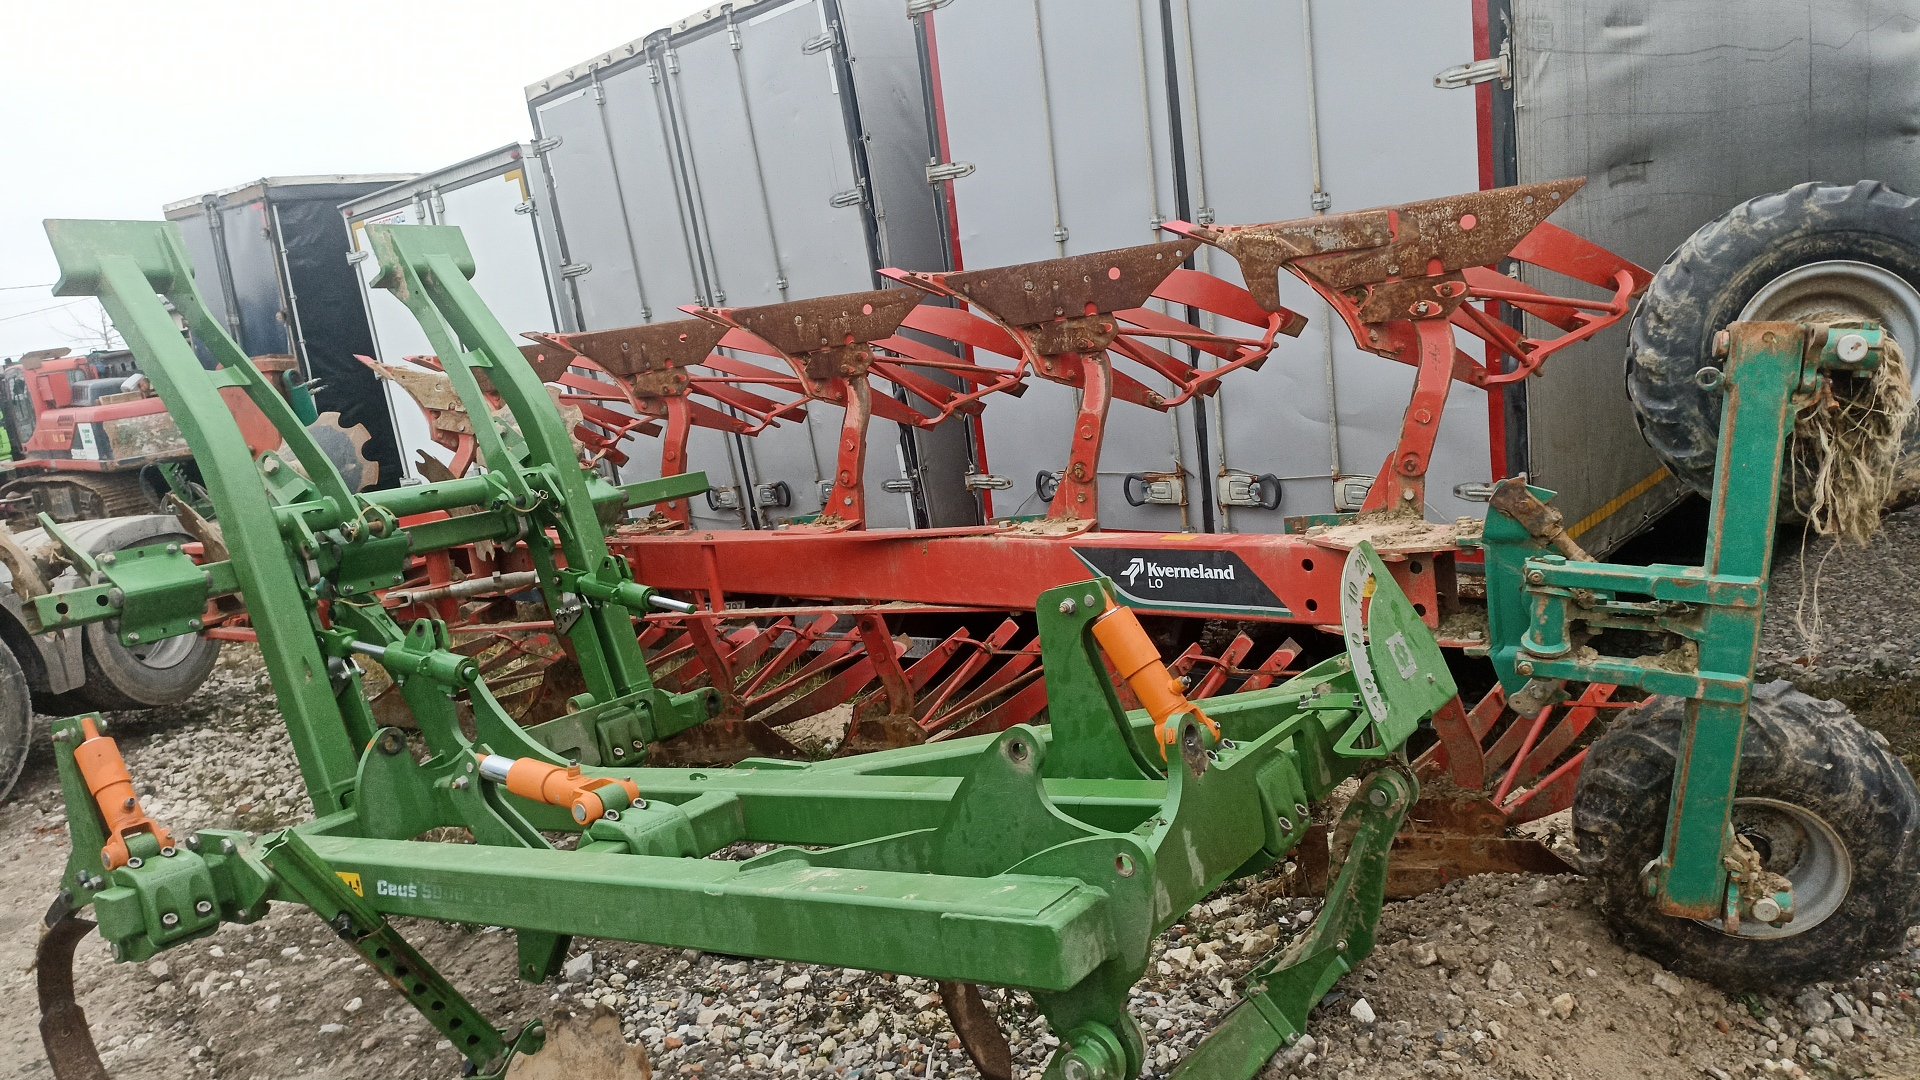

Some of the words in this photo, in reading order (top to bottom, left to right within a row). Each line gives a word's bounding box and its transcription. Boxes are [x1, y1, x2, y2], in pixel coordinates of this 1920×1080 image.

[1147, 562, 1235, 580] Kverneland
[1354, 553, 1368, 576] 20
[1148, 578, 1164, 589] LO
[1347, 581, 1359, 606] 10
[376, 879, 417, 898] Ceus
